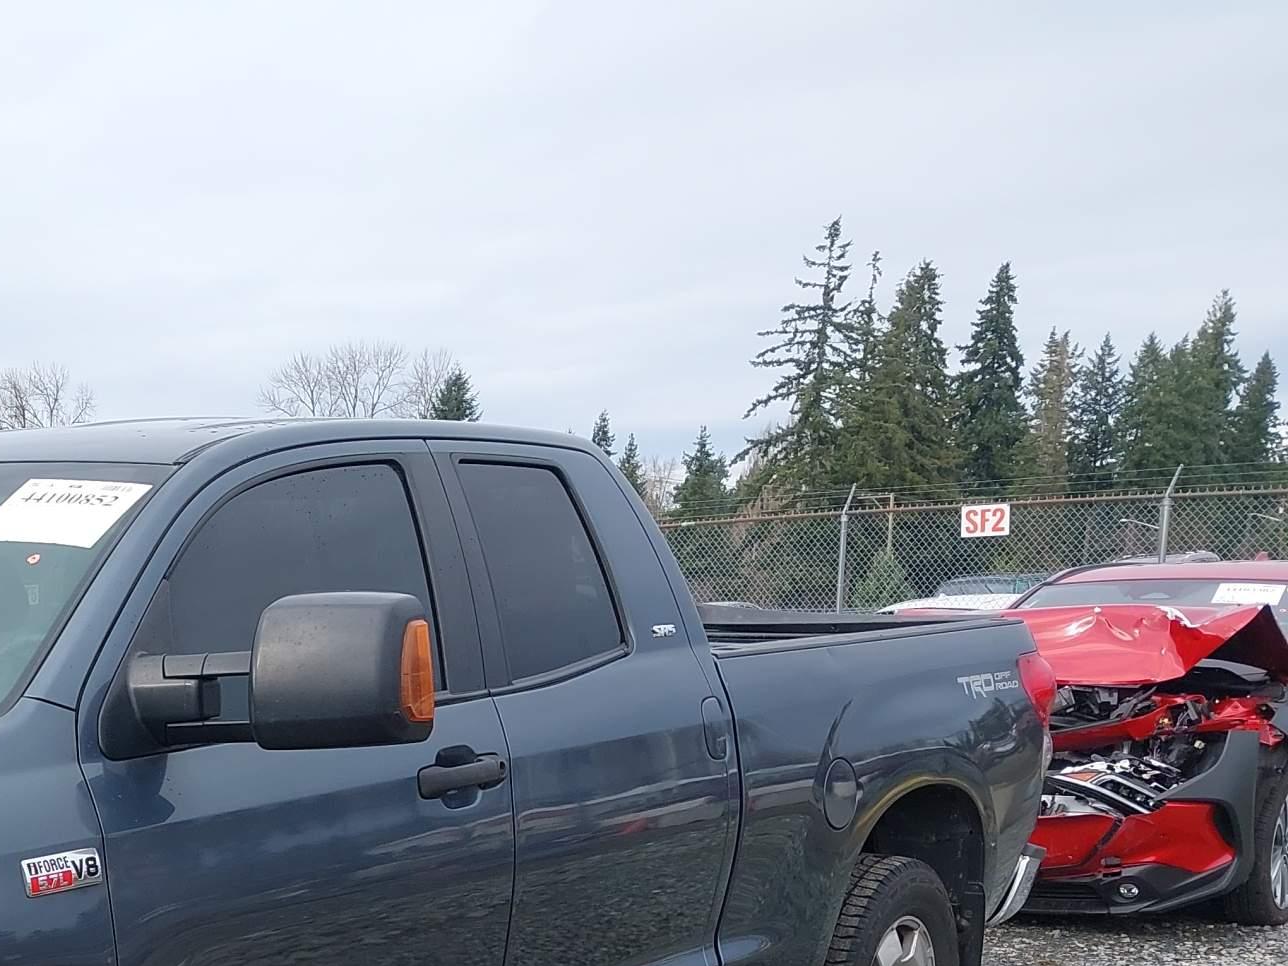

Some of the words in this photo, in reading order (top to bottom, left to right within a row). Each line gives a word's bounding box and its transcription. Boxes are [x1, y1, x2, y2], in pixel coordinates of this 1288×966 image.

[20, 491, 119, 507] 44100852
[965, 508, 1006, 533] SF2
[994, 671, 1011, 680] OFF
[995, 680, 1019, 690] ROAD
[957, 673, 995, 699] TRD
[71, 856, 99, 880] V8
